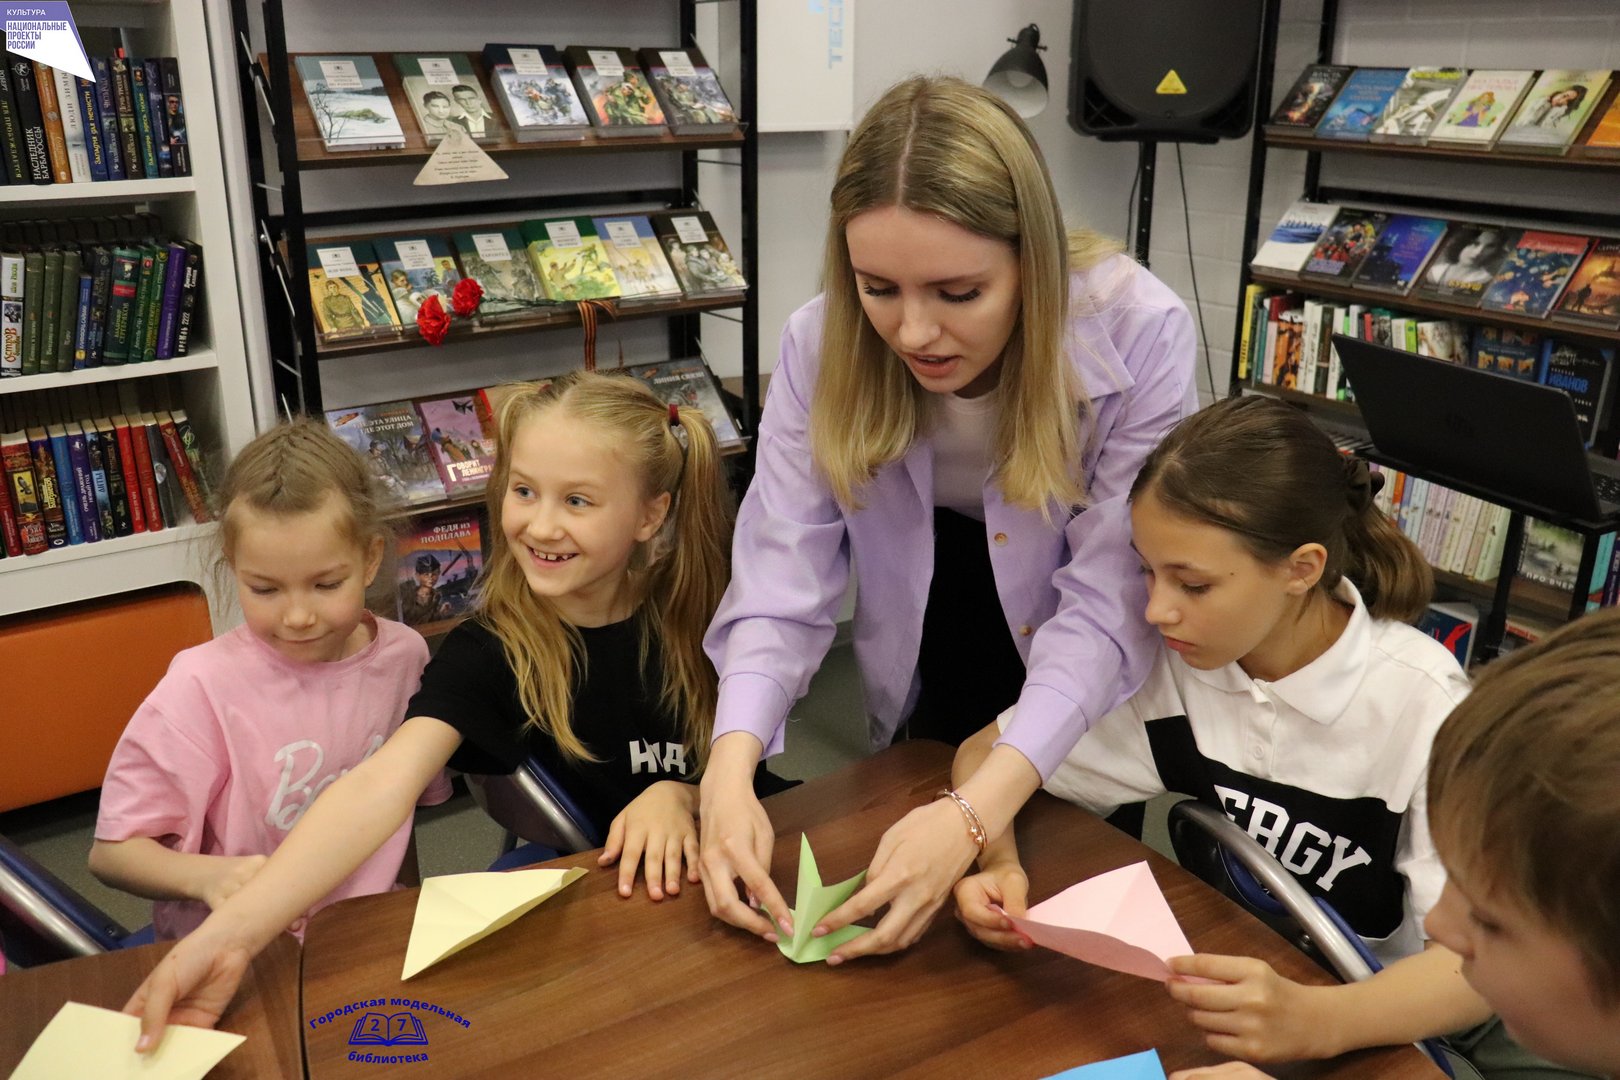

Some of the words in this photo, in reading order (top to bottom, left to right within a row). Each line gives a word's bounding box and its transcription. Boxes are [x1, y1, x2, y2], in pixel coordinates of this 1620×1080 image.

[828, 0, 843, 69] TEC
[61, 72, 72, 98] ЗИМЫ
[66, 103, 77, 129] ЛЮДИ
[26, 128, 42, 180] НАСЛЕДНИК
[34, 126, 50, 180] БАРБАРОССЫ
[182, 312, 190, 325] 2222
[376, 424, 395, 432] ЭТОТ
[397, 421, 414, 430] ДОМ
[384, 415, 411, 424] УЛИЦА
[462, 464, 494, 477] ЛЕНИНГРА
[433, 524, 458, 533] ФЕДЯ
[421, 530, 471, 543] ПОДПЛАВА
[1526, 572, 1545, 582] ПРО
[1549, 578, 1574, 590] ВЧЕР
